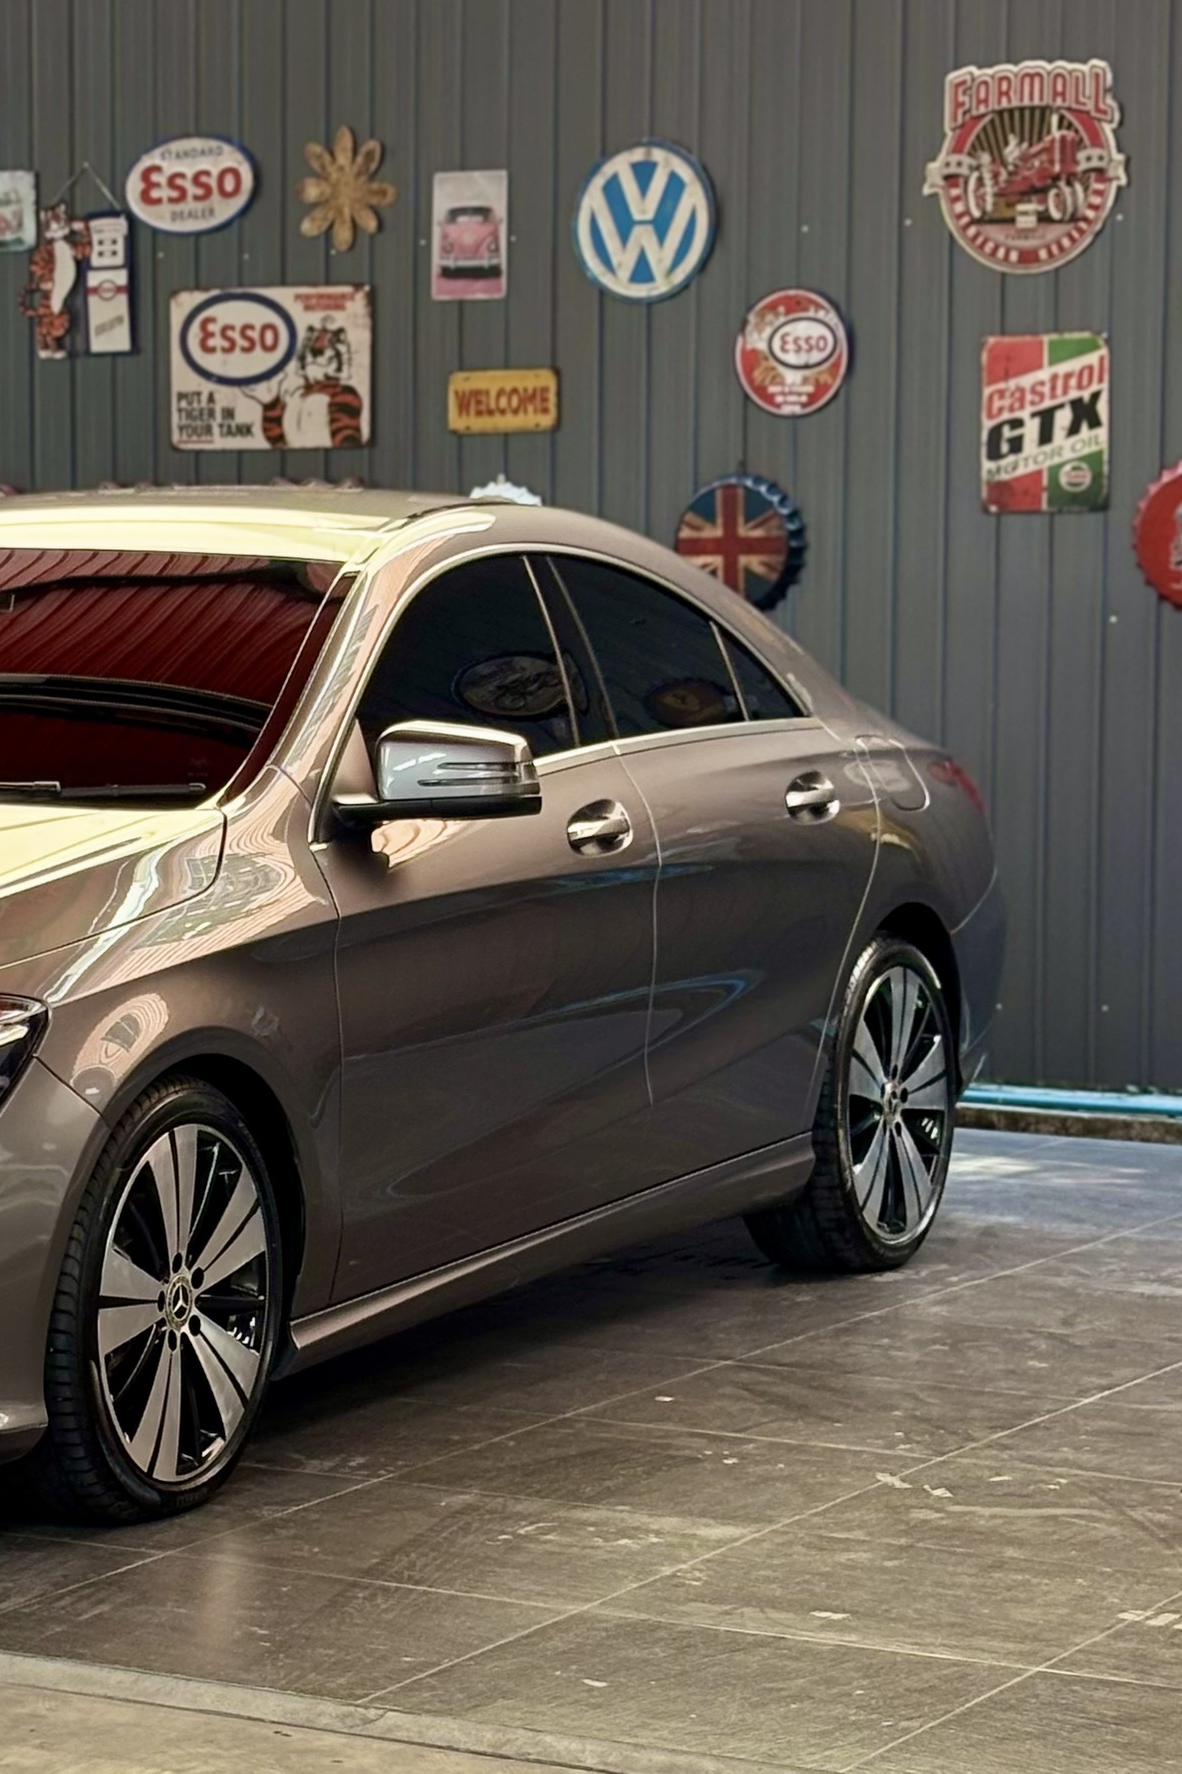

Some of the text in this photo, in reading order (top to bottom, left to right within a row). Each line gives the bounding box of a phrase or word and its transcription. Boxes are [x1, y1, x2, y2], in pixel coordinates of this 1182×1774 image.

[950, 68, 1110, 128] FARMALL
[161, 146, 223, 160] STANDARD
[171, 208, 215, 222] DEALER
[177, 391, 216, 406] PUT A
[986, 354, 1105, 421] Castrol
[454, 386, 551, 417] WELCOME
[177, 407, 236, 422] TIGER IN
[986, 389, 1103, 462] GTX
[178, 422, 254, 438] YOUR TANK
[986, 434, 1103, 480] MOTOR OIL
